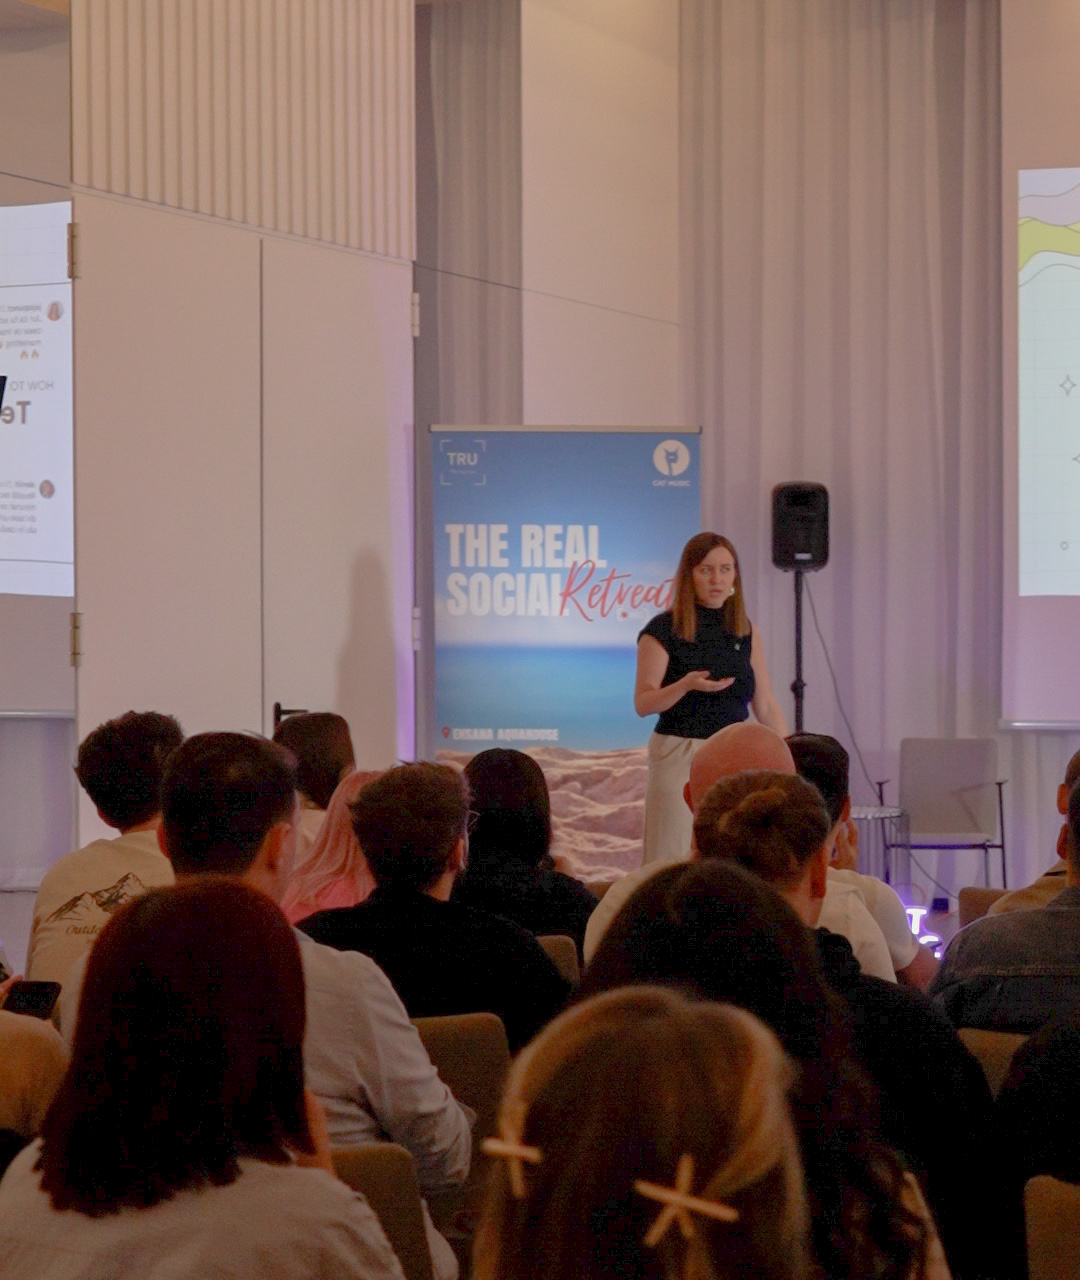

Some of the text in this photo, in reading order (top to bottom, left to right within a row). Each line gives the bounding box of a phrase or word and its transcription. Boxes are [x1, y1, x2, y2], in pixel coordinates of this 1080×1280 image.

[447, 452, 478, 466] TRU
[445, 524, 608, 569] THE REAL
[446, 572, 570, 618] SOCIAL
